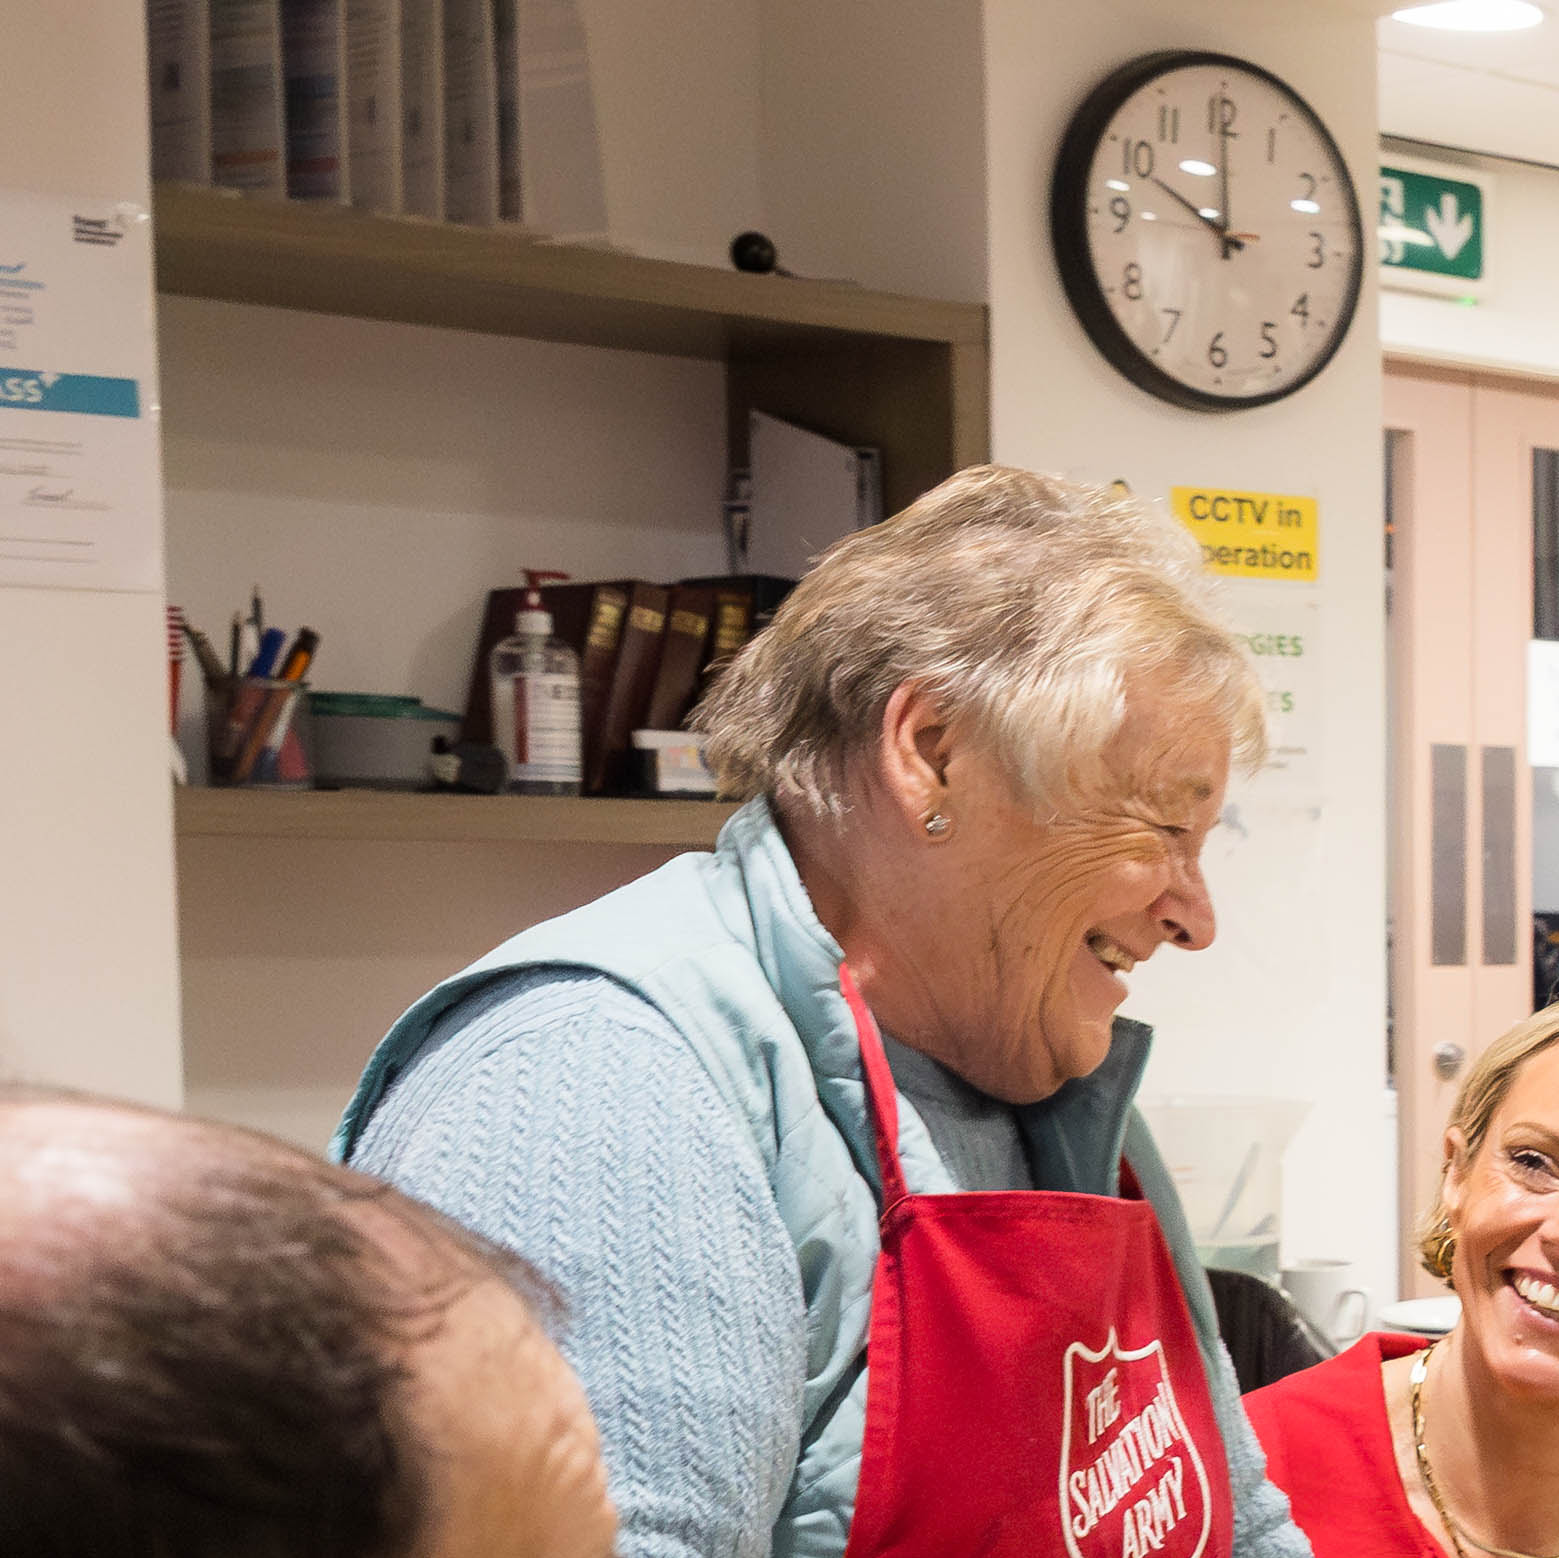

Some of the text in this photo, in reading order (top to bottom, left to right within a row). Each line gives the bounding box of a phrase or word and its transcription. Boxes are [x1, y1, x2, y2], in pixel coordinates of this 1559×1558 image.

[1157, 104, 1180, 144] 11
[1207, 97, 1239, 139] 12
[1123, 138, 1154, 178] 10
[1109, 196, 1131, 233] 9
[1306, 232, 1325, 269] 3
[1123, 261, 1143, 301] 8
[1162, 307, 1183, 343] 7
[1291, 292, 1311, 328] 4
[1208, 331, 1227, 368] 6
[1259, 321, 1278, 359] 5
[1190, 495, 1303, 527] CCTV in
[1200, 543, 1312, 571] peration
[1084, 1366, 1122, 1446] THE
[1070, 1381, 1182, 1538] SALVATION
